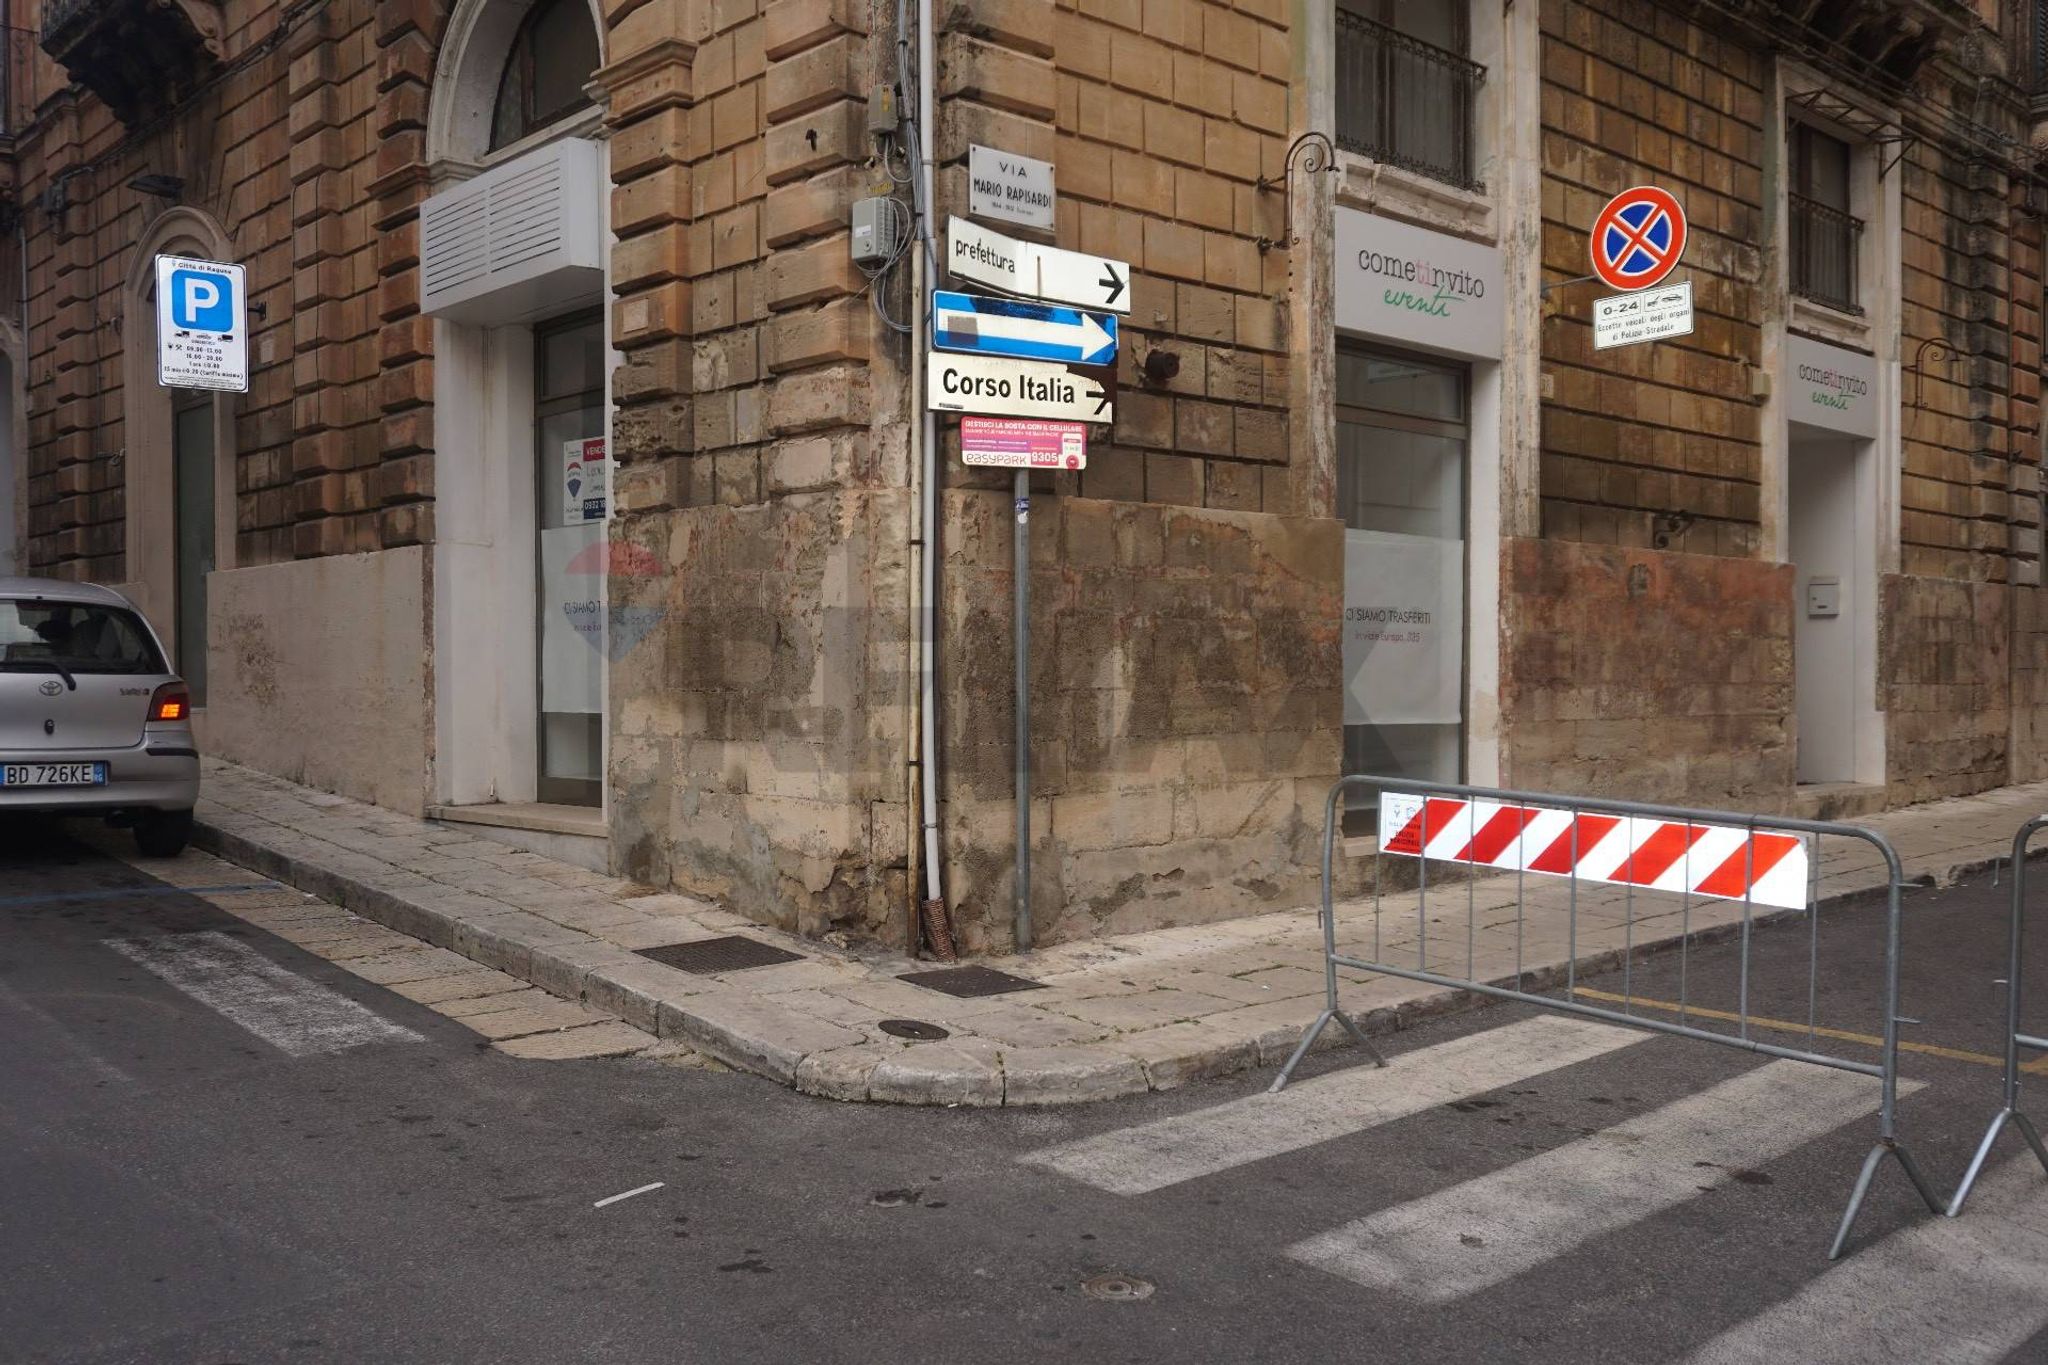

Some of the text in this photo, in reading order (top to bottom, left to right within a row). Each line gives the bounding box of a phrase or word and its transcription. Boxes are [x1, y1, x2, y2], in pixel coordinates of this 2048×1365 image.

[999, 161, 1027, 178] VIA
[973, 178, 1051, 208] MARIO RAPISARDI
[955, 238, 1016, 273] prefettura
[1358, 249, 1485, 298] cometinvito
[185, 278, 220, 322] P
[1383, 285, 1466, 317] eventi
[1603, 302, 1639, 315] 0-24
[943, 368, 1075, 404] Corso Italia
[1031, 451, 1058, 463] 9305
[1356, 608, 1386, 622] SIAMO
[1388, 610, 1432, 625] TRASFERITI
[7, 765, 91, 784] BD 726KE
